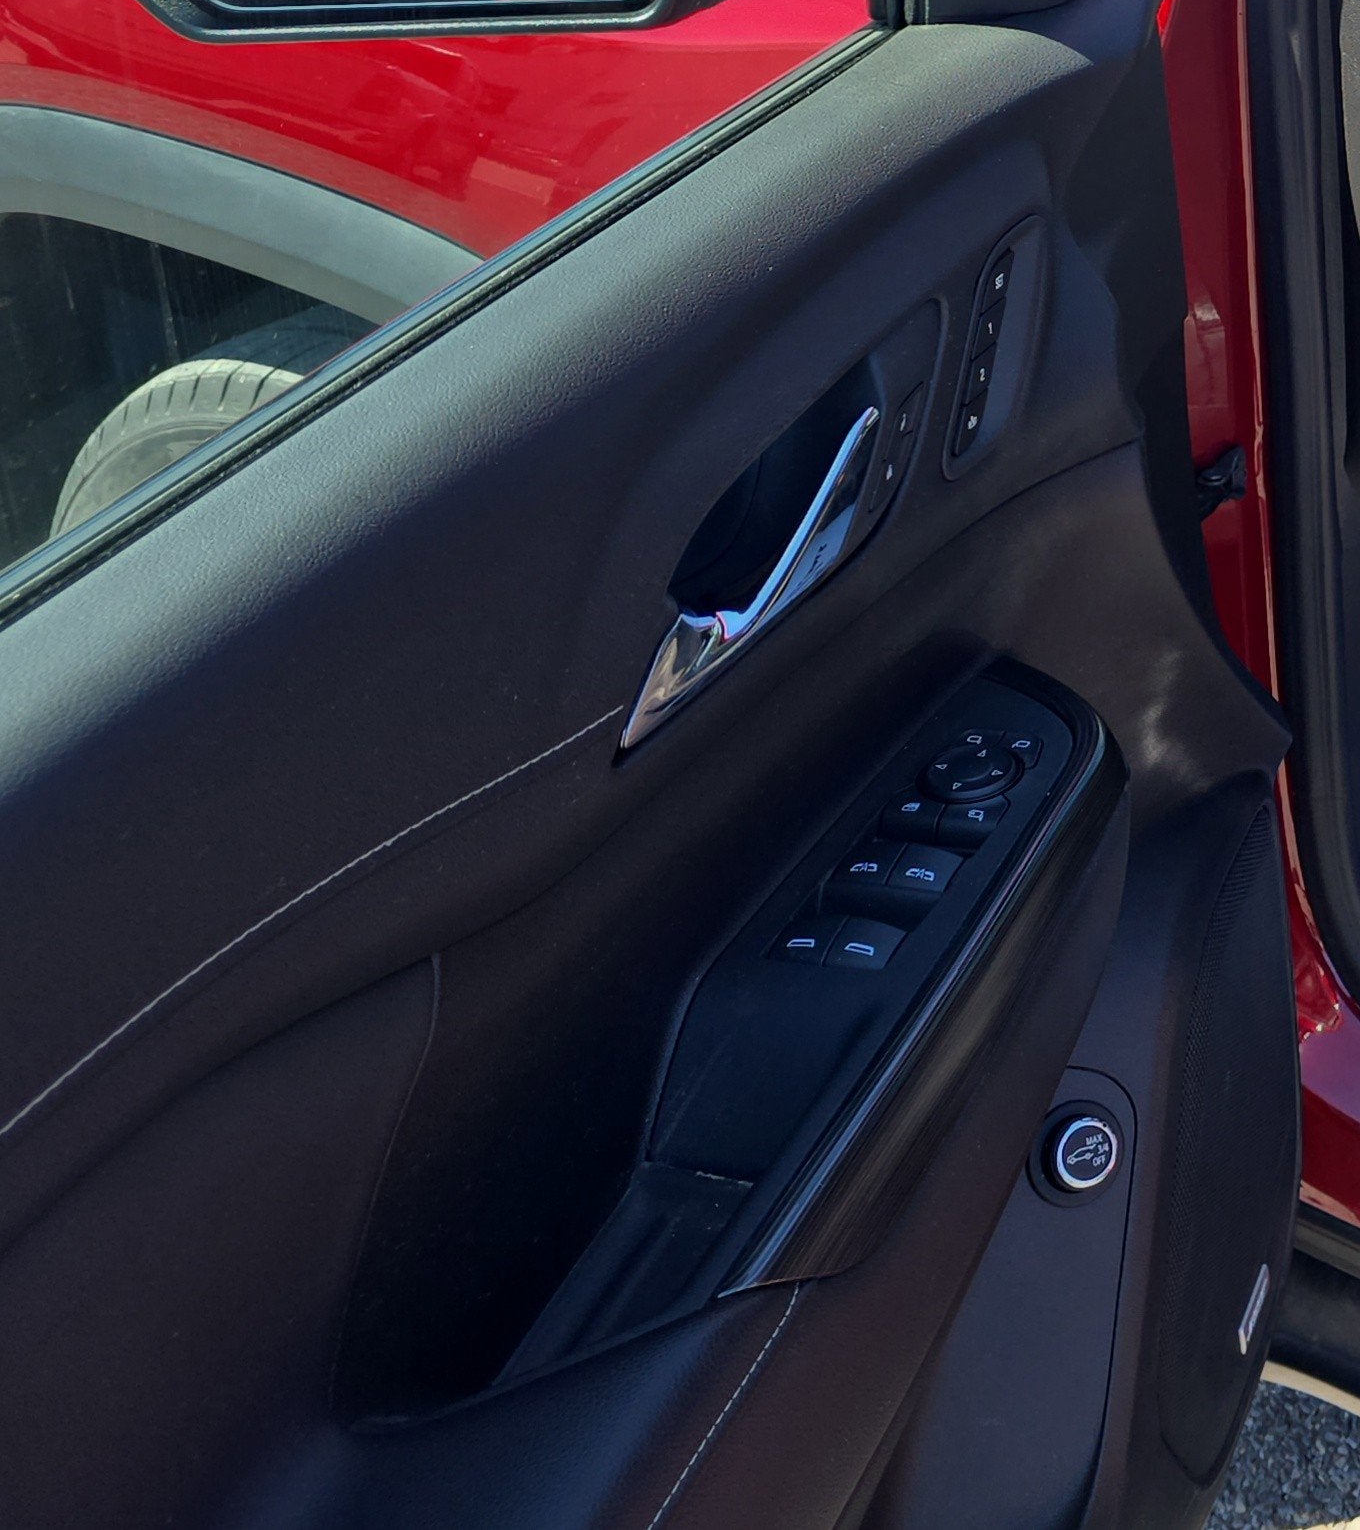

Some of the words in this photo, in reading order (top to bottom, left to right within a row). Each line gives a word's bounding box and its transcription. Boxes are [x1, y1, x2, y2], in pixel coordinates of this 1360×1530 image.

[979, 368, 986, 382] 2
[1086, 1134, 1103, 1145] MAX
[1092, 1155, 1105, 1167] OFF
